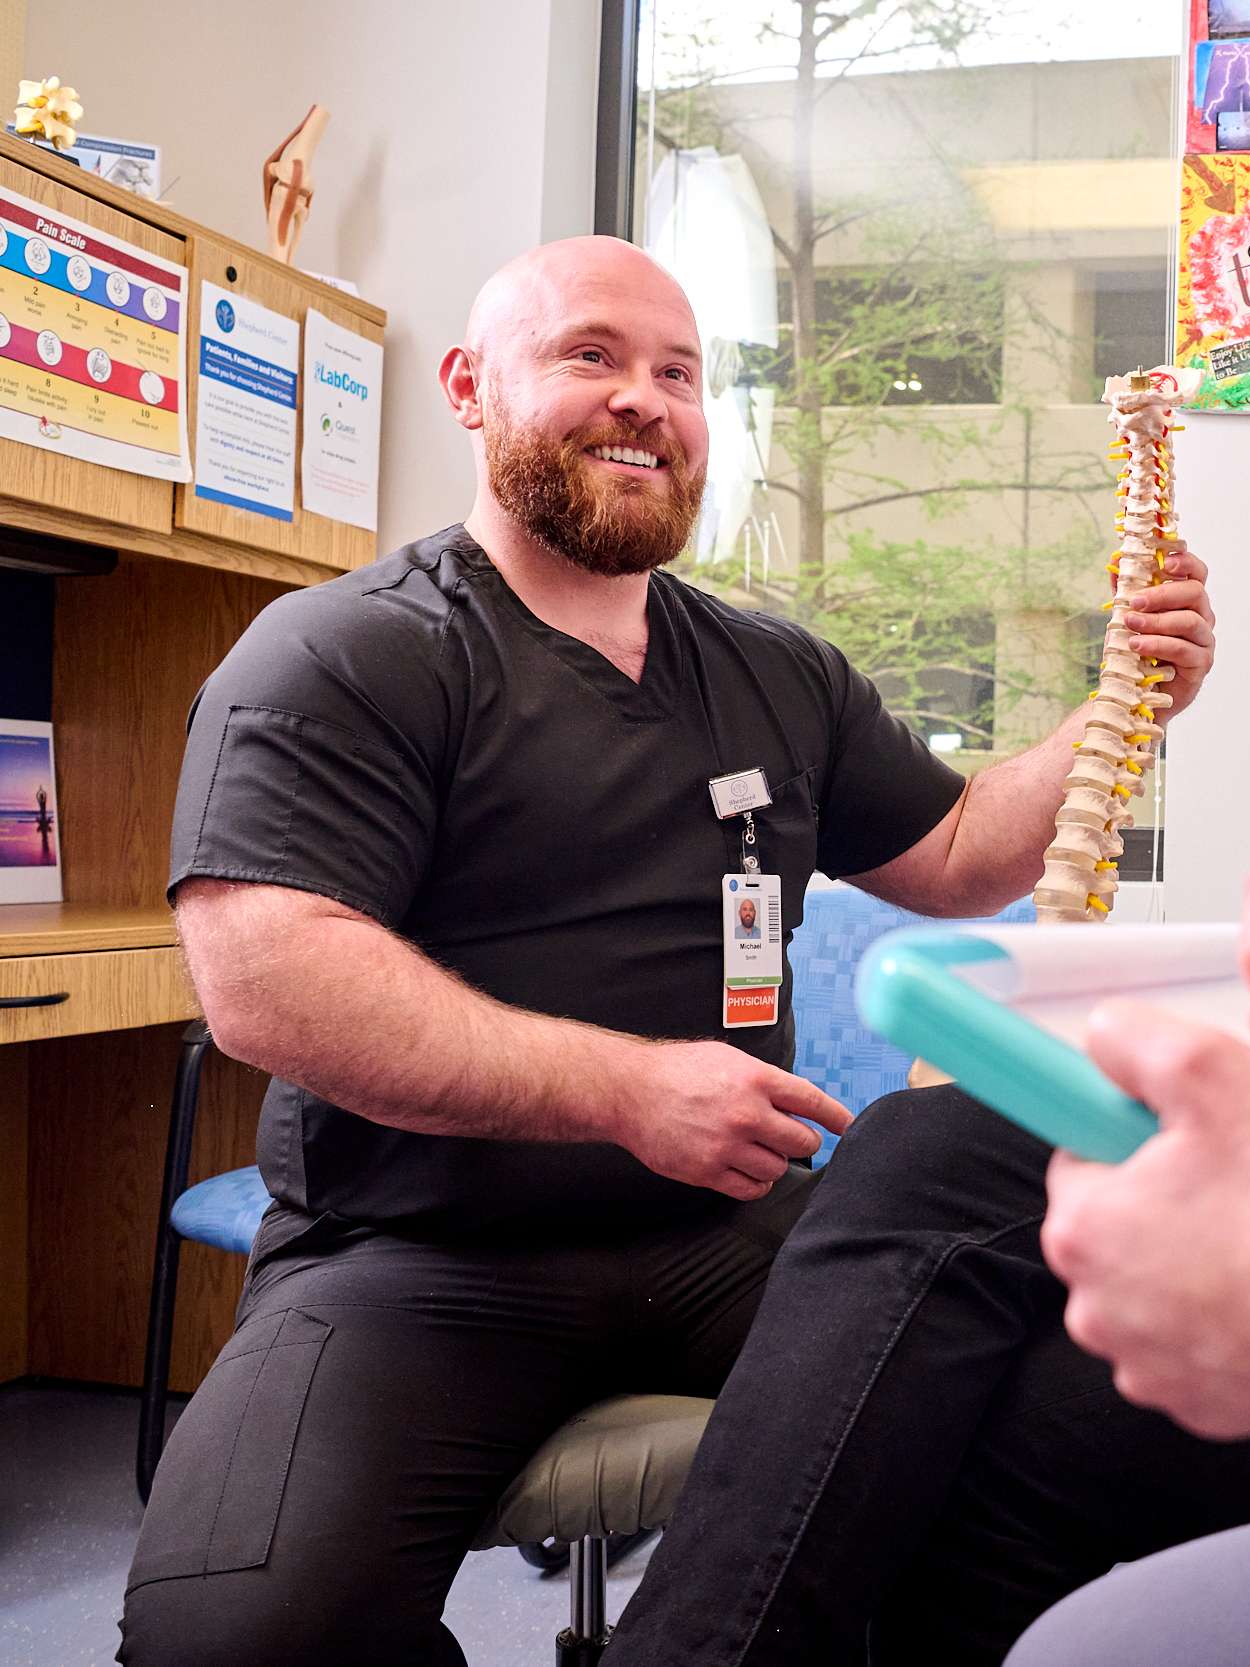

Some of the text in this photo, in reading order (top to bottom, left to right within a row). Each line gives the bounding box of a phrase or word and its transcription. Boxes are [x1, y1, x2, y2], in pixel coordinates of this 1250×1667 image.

[122, 145, 153, 158] Fractures
[36, 218, 86, 250] Pain Scale
[33, 286, 39, 296] 2
[74, 302, 80, 312] 3
[114, 318, 119, 327] 4
[151, 331, 156, 340] 5
[1210, 349, 1233, 361] Enjoy
[1212, 359, 1232, 371] Like
[1216, 367, 1238, 380] to Be
[45, 378, 51, 388] 8
[320, 364, 368, 401] LabCorp
[94, 394, 99, 404] 9
[141, 408, 150, 419] 10
[728, 794, 756, 806] Shepherd
[728, 995, 774, 1008] PHYSICIAN
